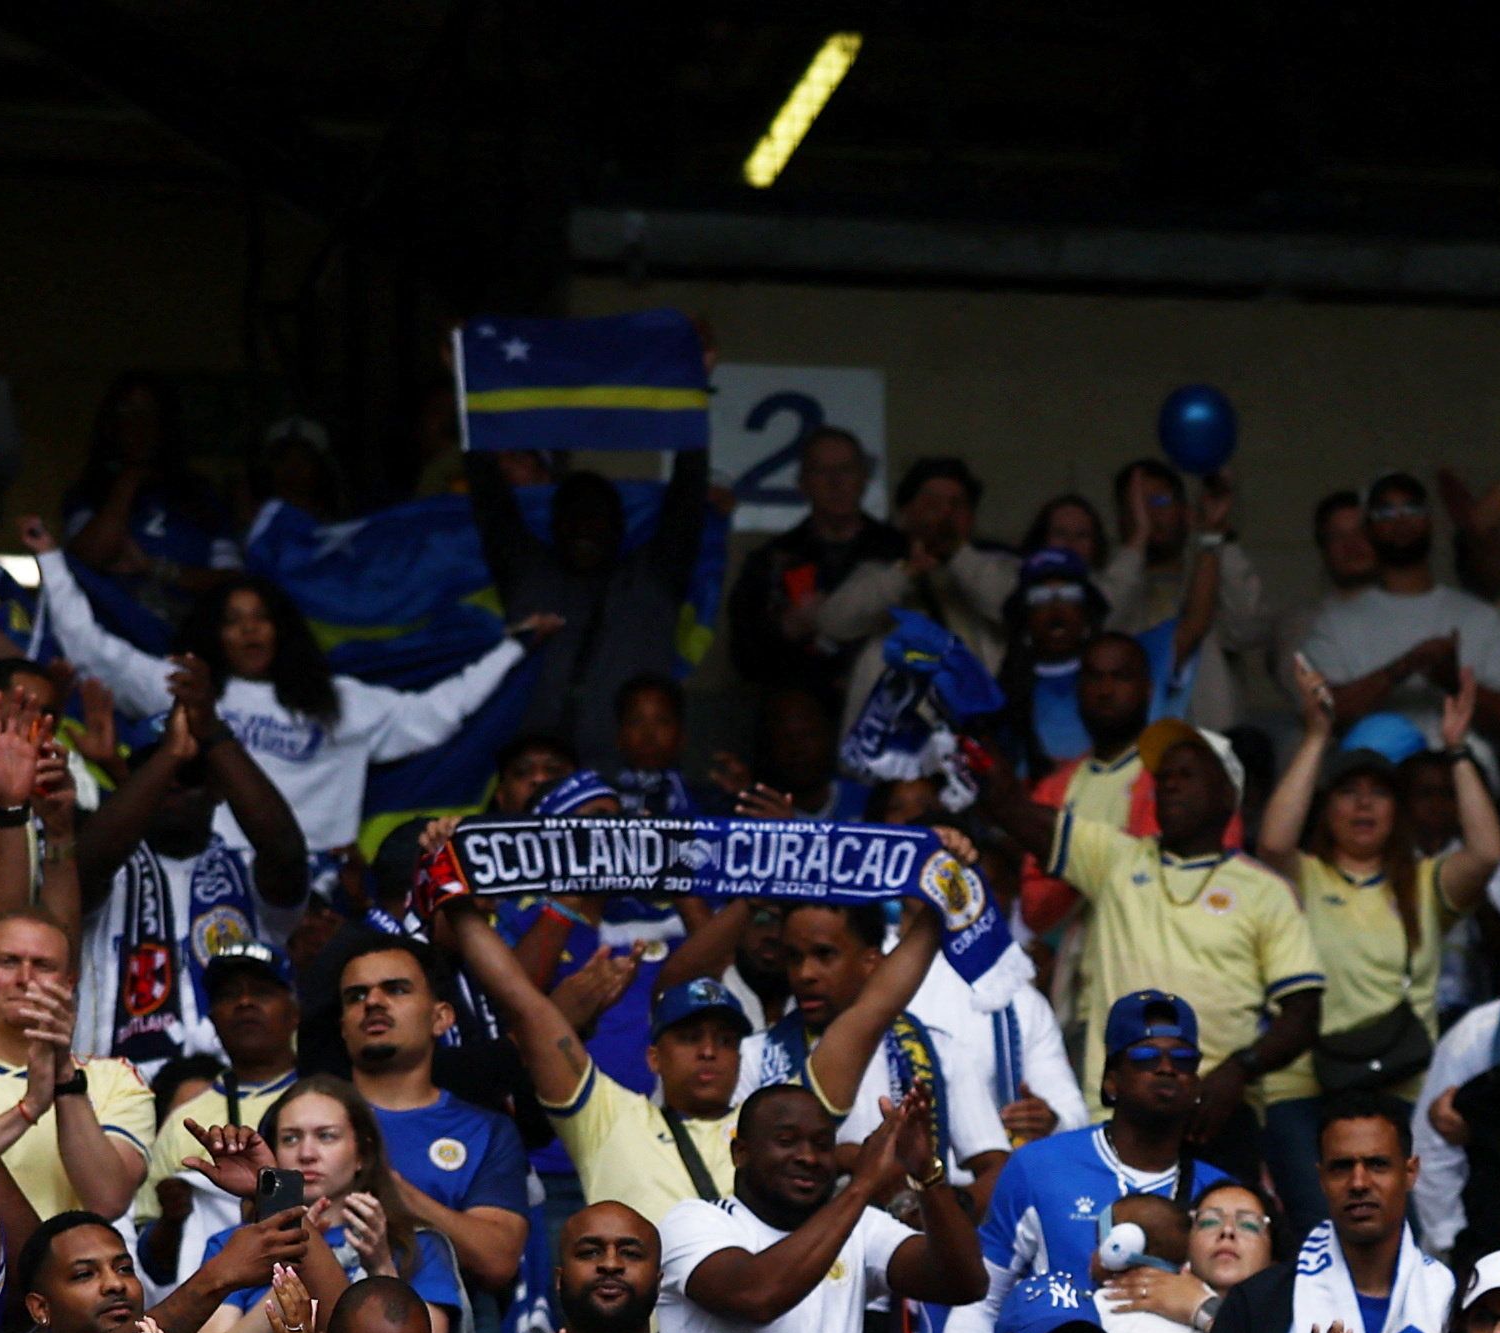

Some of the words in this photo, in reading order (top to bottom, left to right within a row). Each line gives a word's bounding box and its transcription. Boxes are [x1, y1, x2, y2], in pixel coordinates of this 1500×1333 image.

[729, 391, 825, 504] 2
[729, 820, 833, 834] FRIENDLY
[464, 829, 667, 886] SCOTLAND
[549, 878, 660, 893] SATURDAY
[716, 880, 764, 895] MAY
